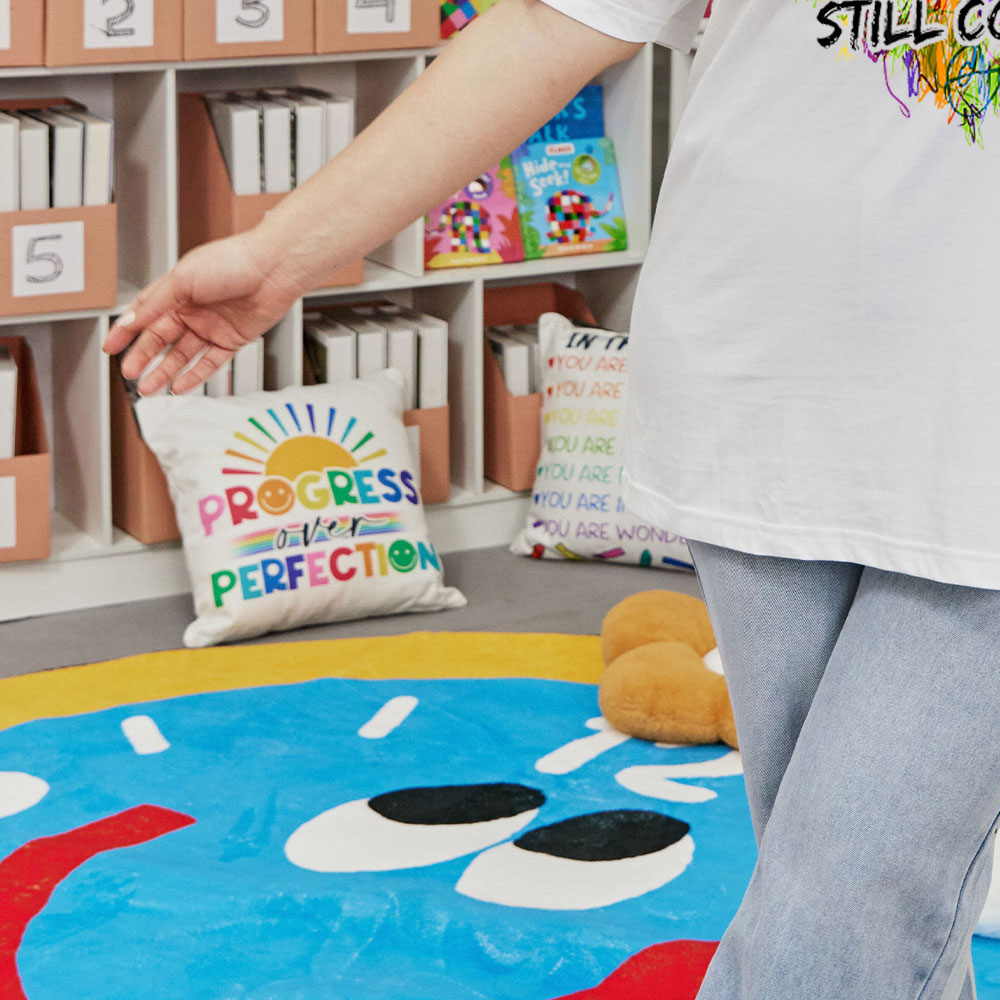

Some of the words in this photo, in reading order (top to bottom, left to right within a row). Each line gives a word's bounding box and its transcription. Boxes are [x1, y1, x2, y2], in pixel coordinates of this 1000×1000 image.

[816, 0, 946, 51] STILL
[522, 157, 558, 180] Hide
[529, 168, 570, 197] Seek!
[26, 233, 64, 284] 5
[565, 332, 597, 349] IN
[555, 356, 592, 373] YOU
[595, 357, 630, 373] ARE
[555, 380, 587, 398] YOU
[589, 381, 625, 400] ARE
[584, 407, 618, 428] ARE
[582, 436, 617, 456] ARE
[542, 463, 575, 482] YOU
[579, 464, 614, 485] ARE
[198, 468, 420, 538] PROGRESS
[540, 490, 572, 510] YOU
[577, 492, 612, 513] ARE
[277, 516, 388, 550] over
[576, 520, 610, 540] ARE
[211, 540, 441, 608] PERFECTION
